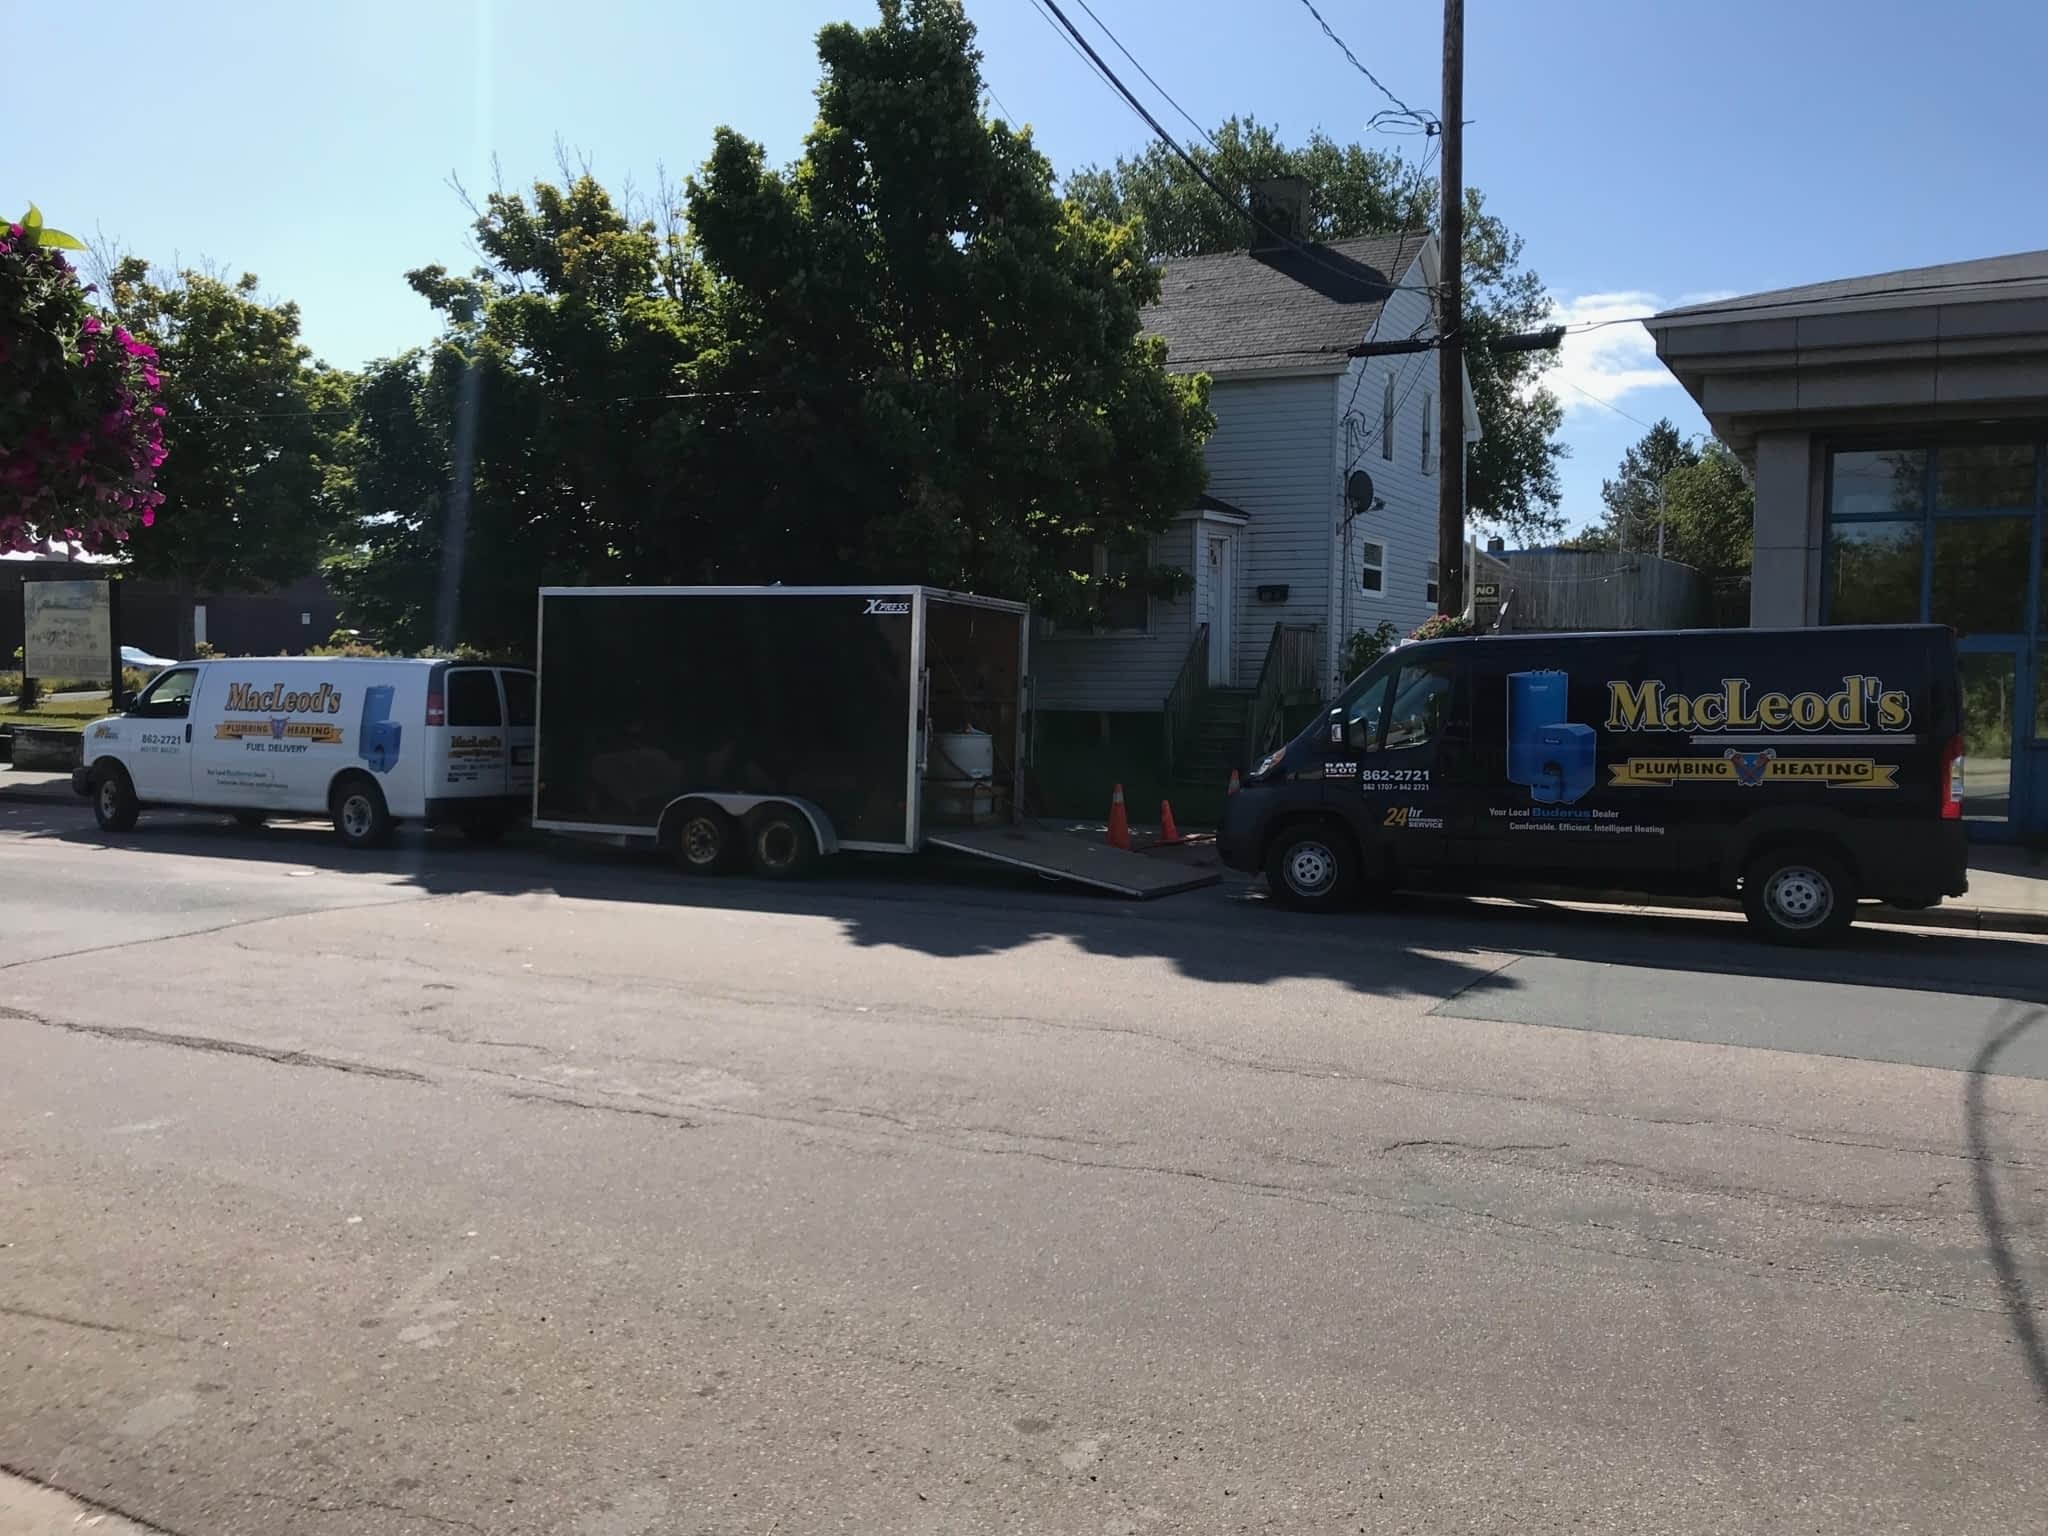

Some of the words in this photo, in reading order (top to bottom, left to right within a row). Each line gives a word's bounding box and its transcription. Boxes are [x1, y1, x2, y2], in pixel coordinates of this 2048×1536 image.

[1476, 586, 1495, 595] NO
[863, 599, 910, 614] XPRESS
[224, 682, 342, 713] MacLeod's
[1604, 675, 1912, 732] MacLeod's
[226, 724, 269, 733] PLUMBING
[287, 725, 330, 735] HEATING
[142, 734, 181, 745] 862-2721
[246, 743, 266, 752] FUEL
[268, 744, 309, 753] DELIVERY
[1634, 761, 1728, 776] PLUMBING
[1772, 762, 1870, 776] HEATING
[1363, 769, 1430, 781] 862-2721
[1384, 807, 1408, 827] 24
[1408, 806, 1423, 818] hr
[1489, 808, 1506, 817] Your
[1508, 808, 1530, 817] Local
[1592, 808, 1619, 818] Dealer
[1594, 823, 1633, 834] Intelligent
[1634, 824, 1665, 834] Heating
